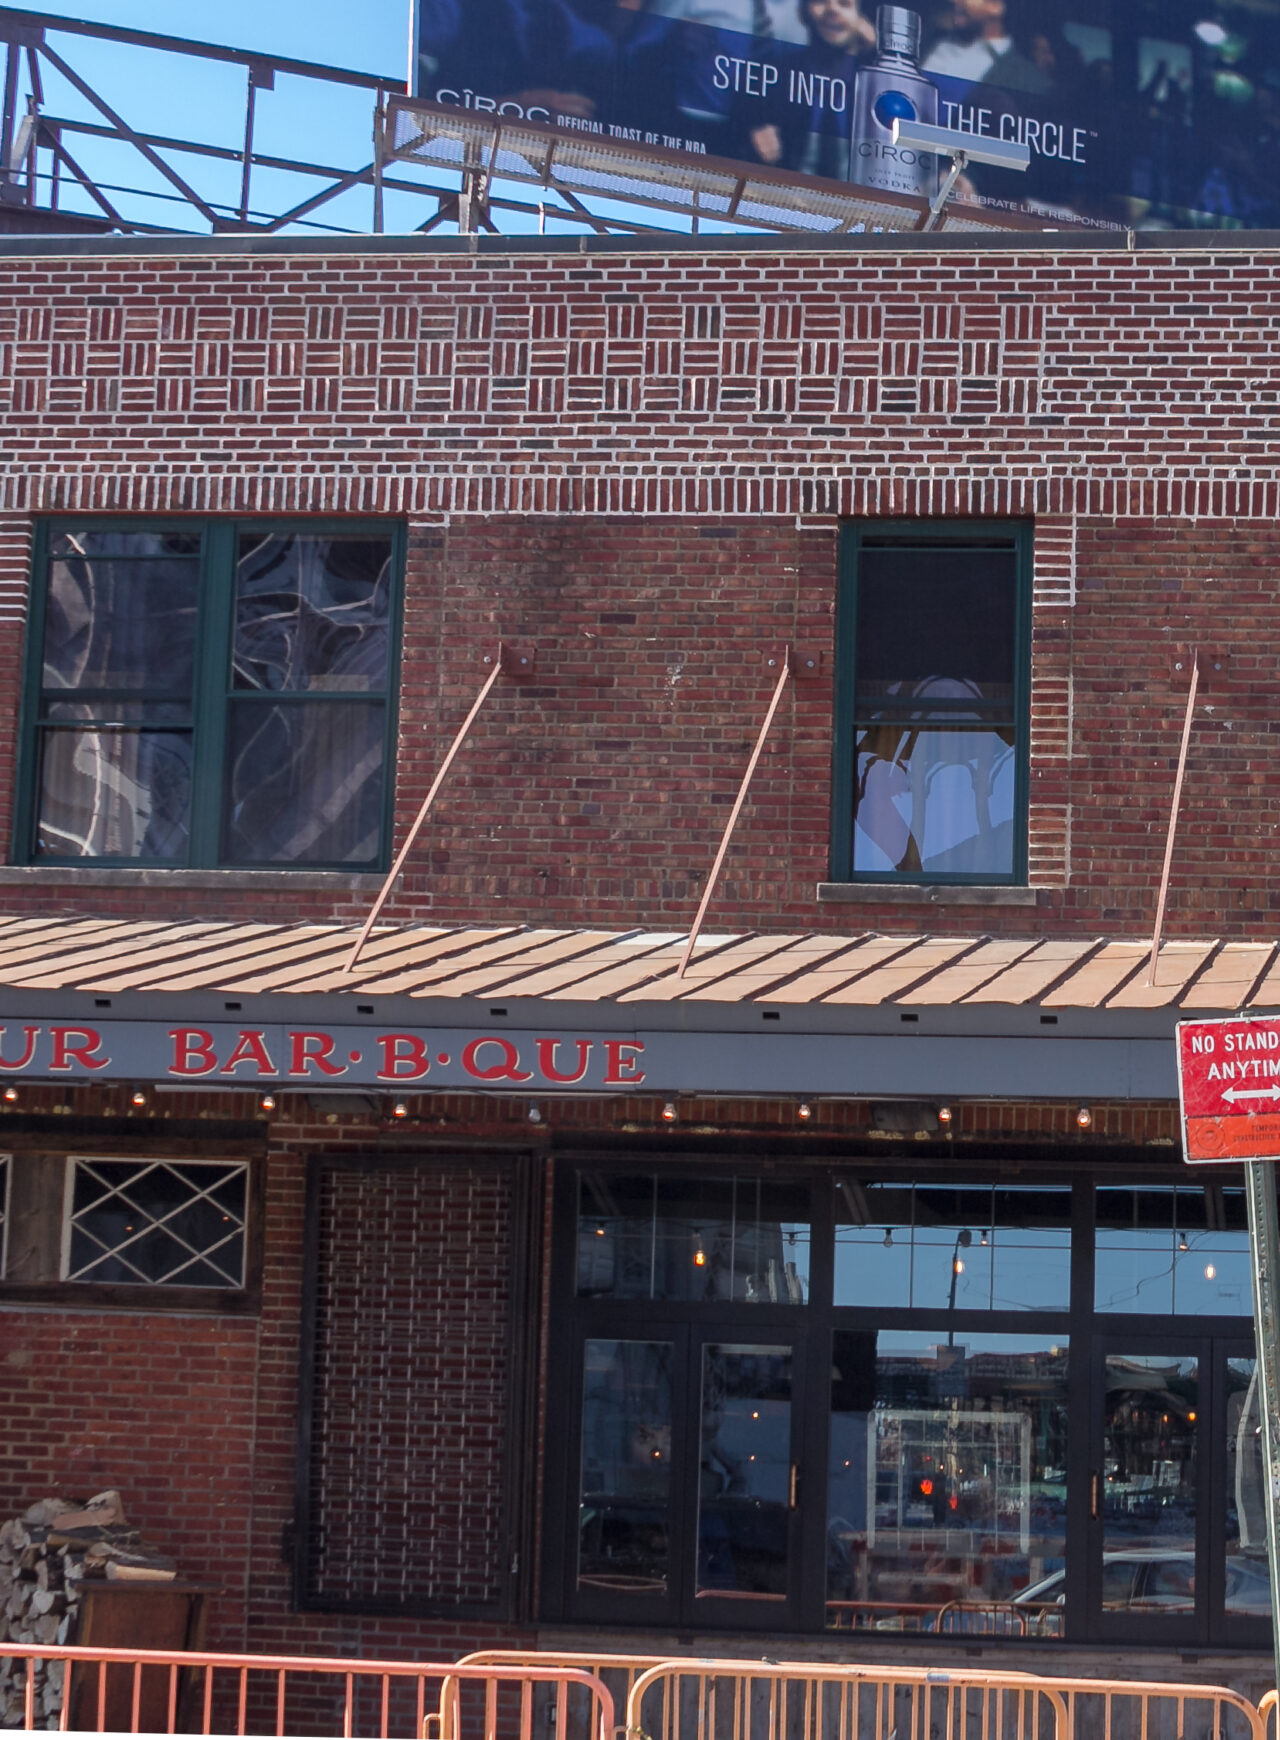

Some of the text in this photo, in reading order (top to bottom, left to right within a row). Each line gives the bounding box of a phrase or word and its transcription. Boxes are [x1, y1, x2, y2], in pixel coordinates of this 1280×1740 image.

[713, 55, 778, 97] STEP
[789, 70, 846, 112] INTO
[942, 100, 992, 137] THE
[1000, 113, 1086, 163] CIRCLE
[557, 115, 604, 135] OFFICIAL
[608, 124, 642, 142] TOAST
[645, 132, 659, 145] OF
[662, 135, 682, 150] THE
[868, 176, 921, 193] VODKA
[948, 190, 1131, 231] CELEBRATE LIFE RESPONSIBLY
[1192, 1035, 1215, 1054] NO
